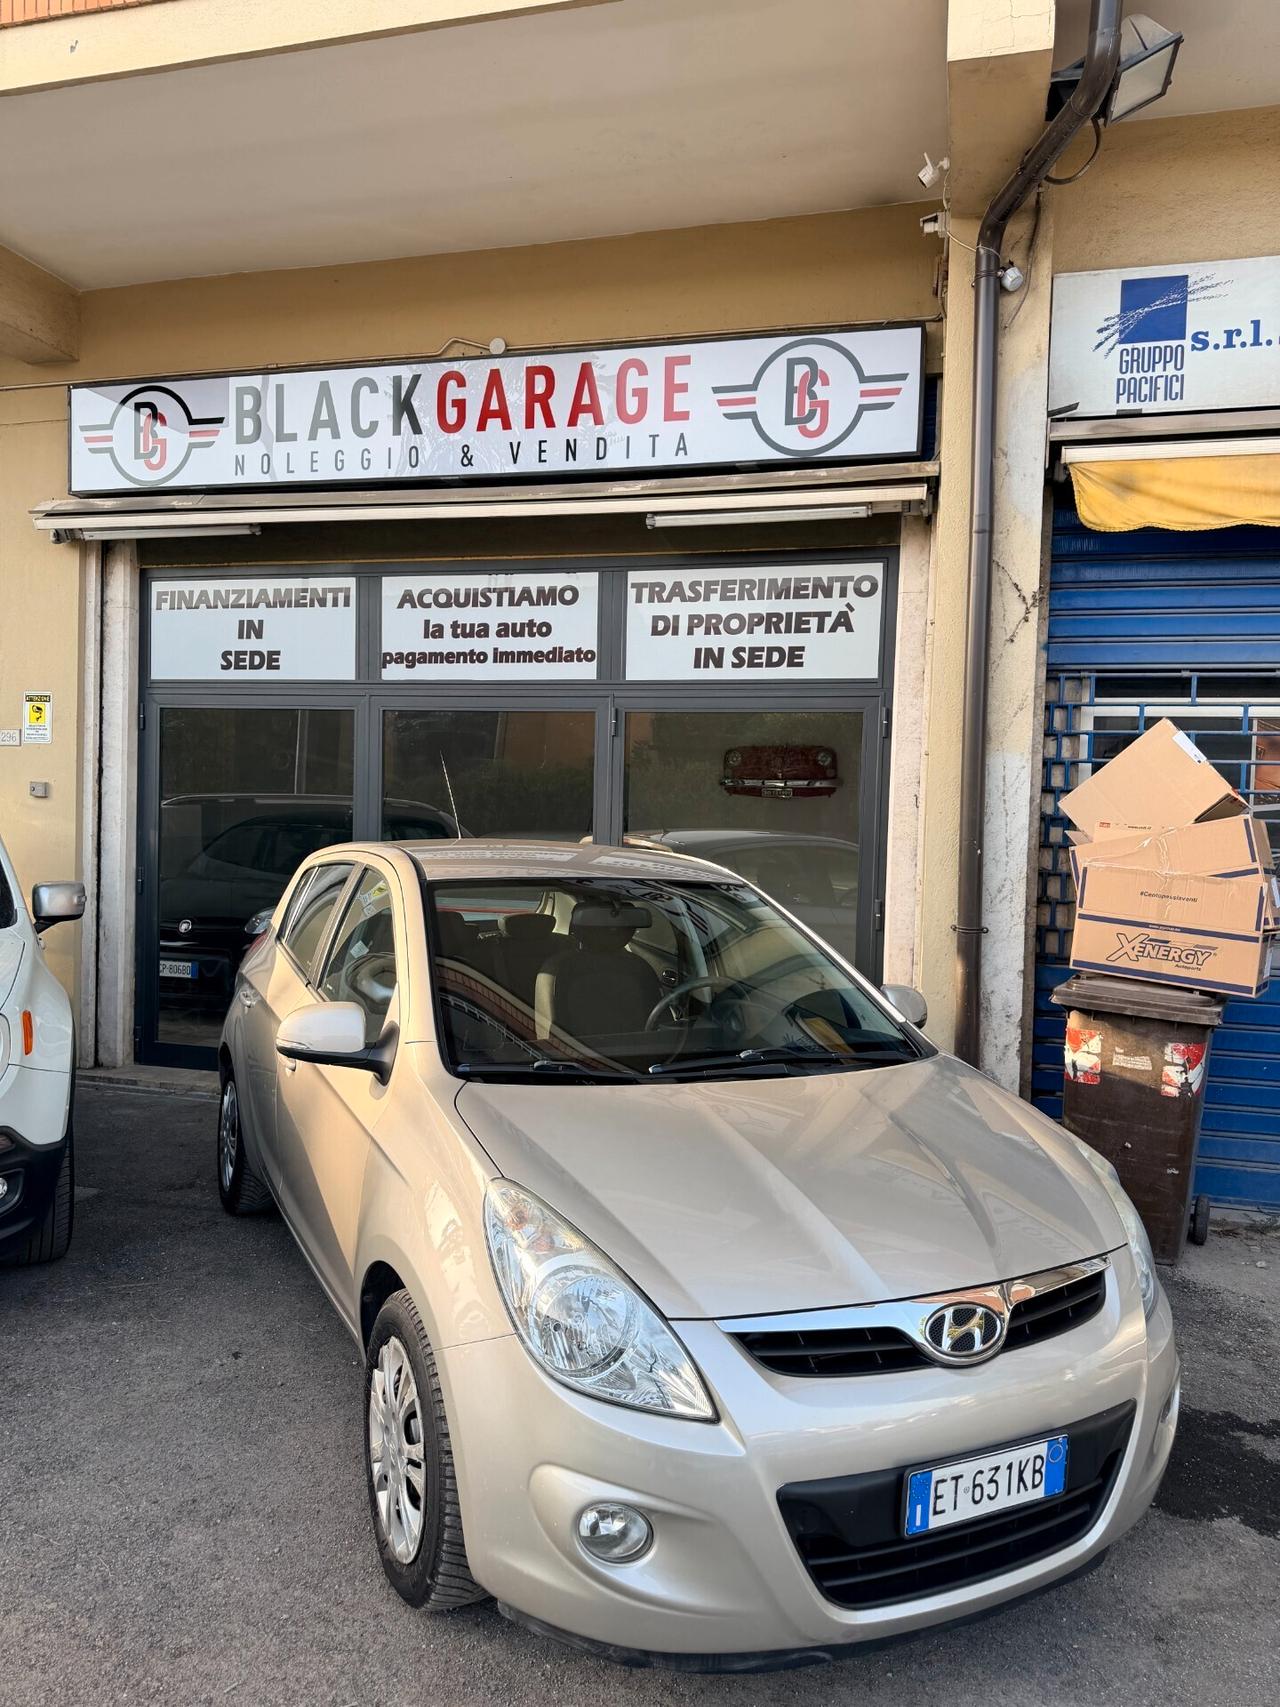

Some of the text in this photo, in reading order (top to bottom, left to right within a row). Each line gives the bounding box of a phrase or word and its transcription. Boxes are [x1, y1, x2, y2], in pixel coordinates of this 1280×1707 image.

[1190, 319, 1273, 352] s.r.l.
[1119, 344, 1185, 375] GRUPPO
[1115, 374, 1185, 405] PACIFICI
[234, 432, 689, 476] NOLEGGIO & VENDITA
[155, 586, 351, 611] FINANZIAMENTI
[396, 584, 580, 609] ACQUISTIAMO
[630, 574, 879, 604] TRASFERIMENTO
[237, 619, 264, 640] IN
[423, 618, 553, 639] la tua auto
[650, 602, 856, 637] DI PROPRIETÀ
[220, 650, 282, 671] SEDE
[381, 646, 597, 669] pagamento immediato
[693, 645, 806, 669] IN SEDE
